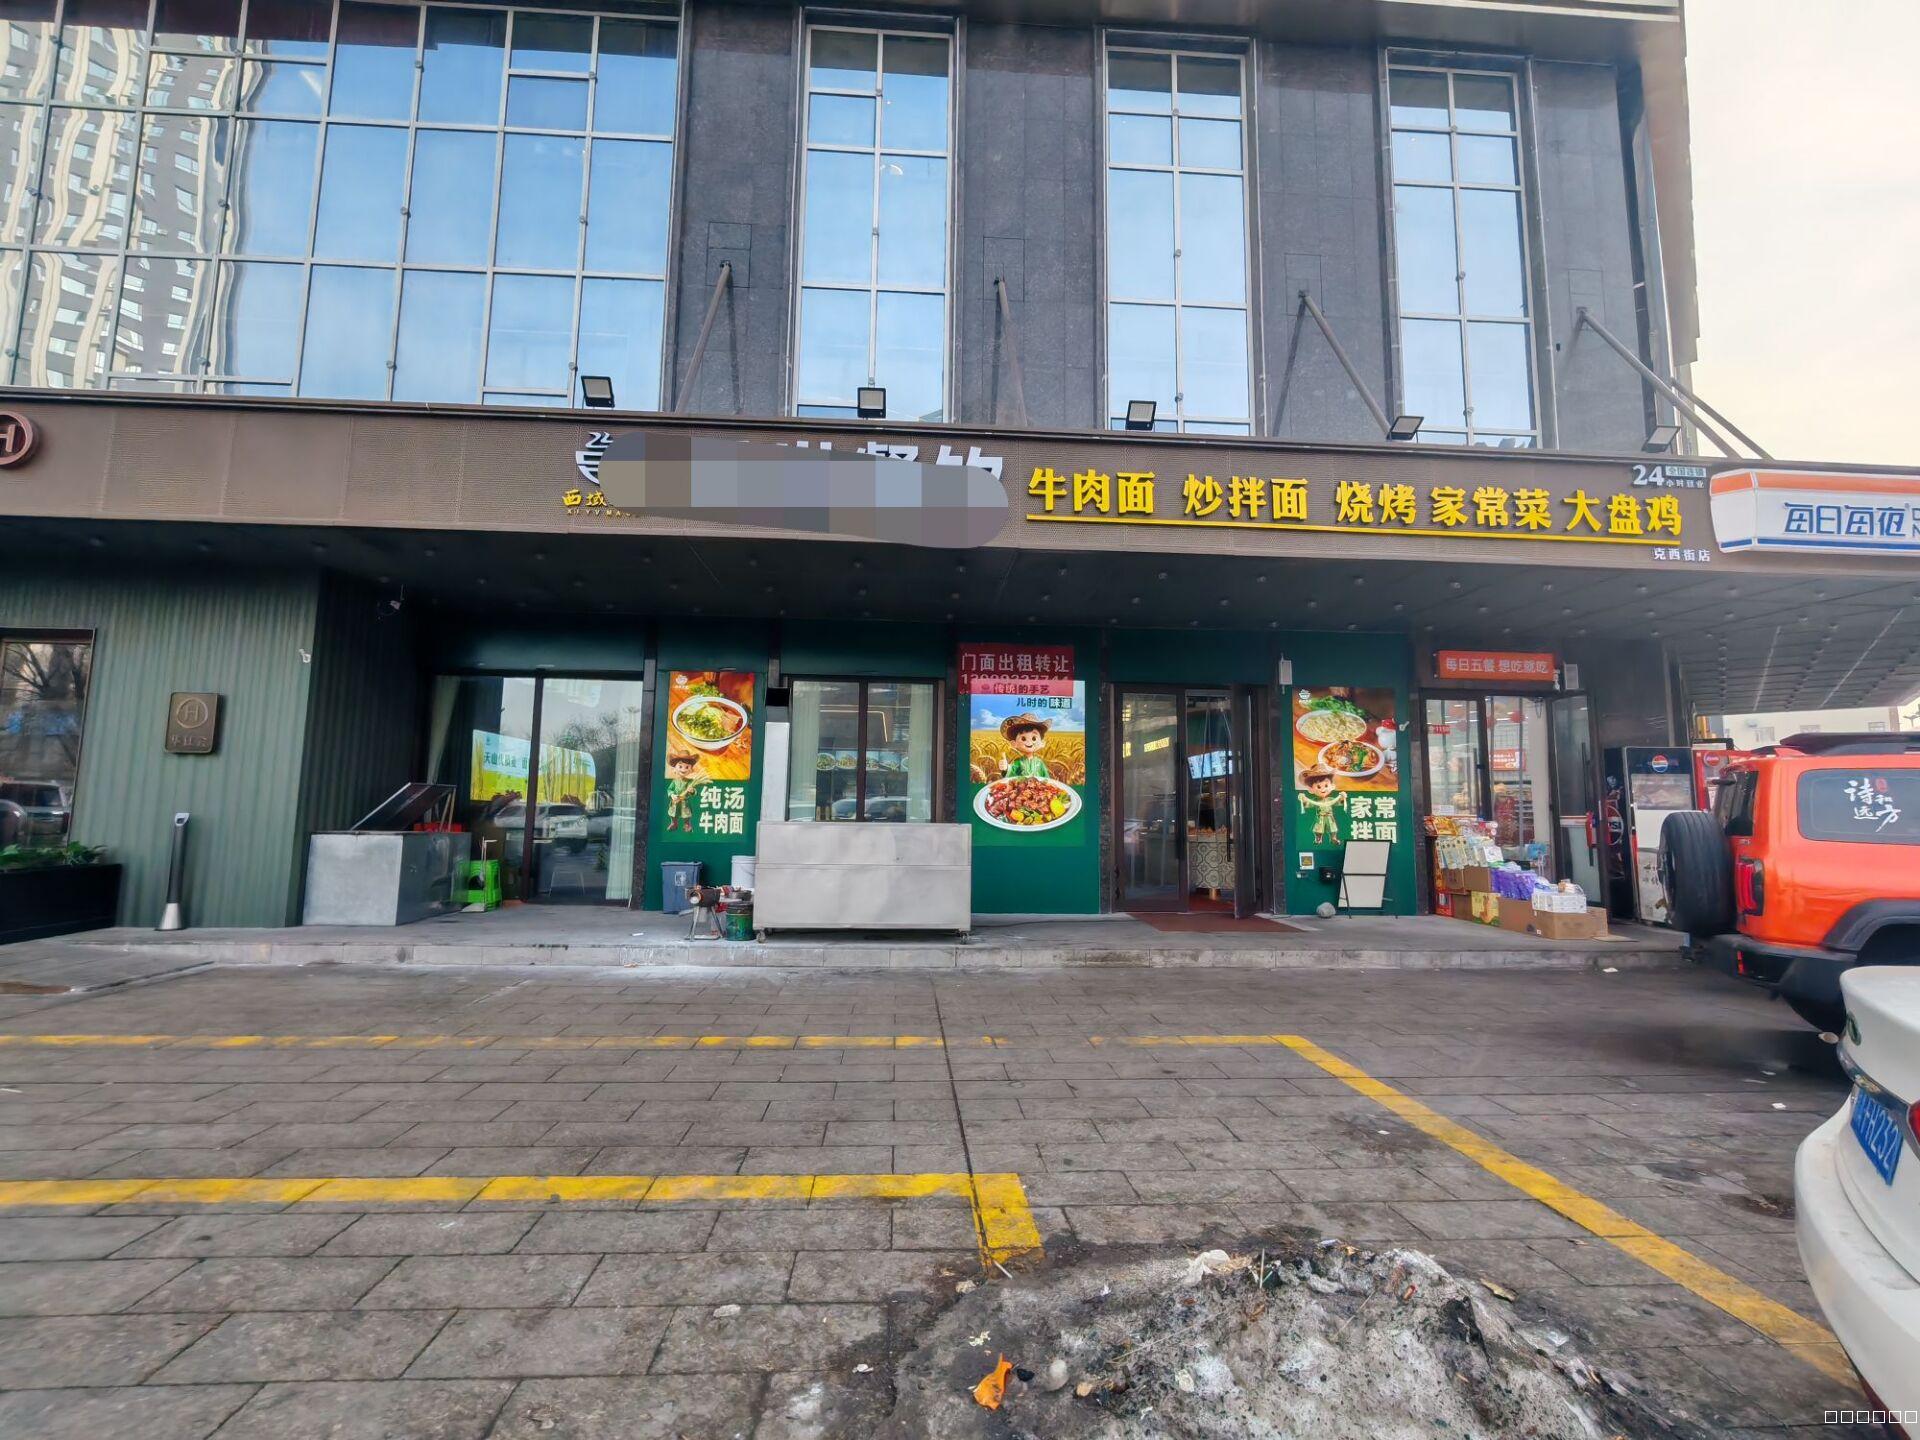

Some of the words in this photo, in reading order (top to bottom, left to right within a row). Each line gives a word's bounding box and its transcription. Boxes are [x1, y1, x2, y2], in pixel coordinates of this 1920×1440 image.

[1632, 464, 1664, 486] 24
[1028, 467, 1156, 514] 牛肉面
[1183, 473, 1309, 520] 炒拌面
[1335, 480, 1416, 525] 烧烤
[1431, 486, 1553, 530] 家常菜
[1563, 489, 1682, 536] 大盘鸡
[1653, 547, 1711, 562] 克西街店
[961, 653, 1070, 672] 门面出租转让
[1446, 658, 1495, 672] 每日五餐
[1016, 696, 1073, 709] 儿时的味道
[700, 786, 744, 808] 纯汤
[1350, 796, 1397, 819] 家常
[699, 811, 744, 834] 牛肉面
